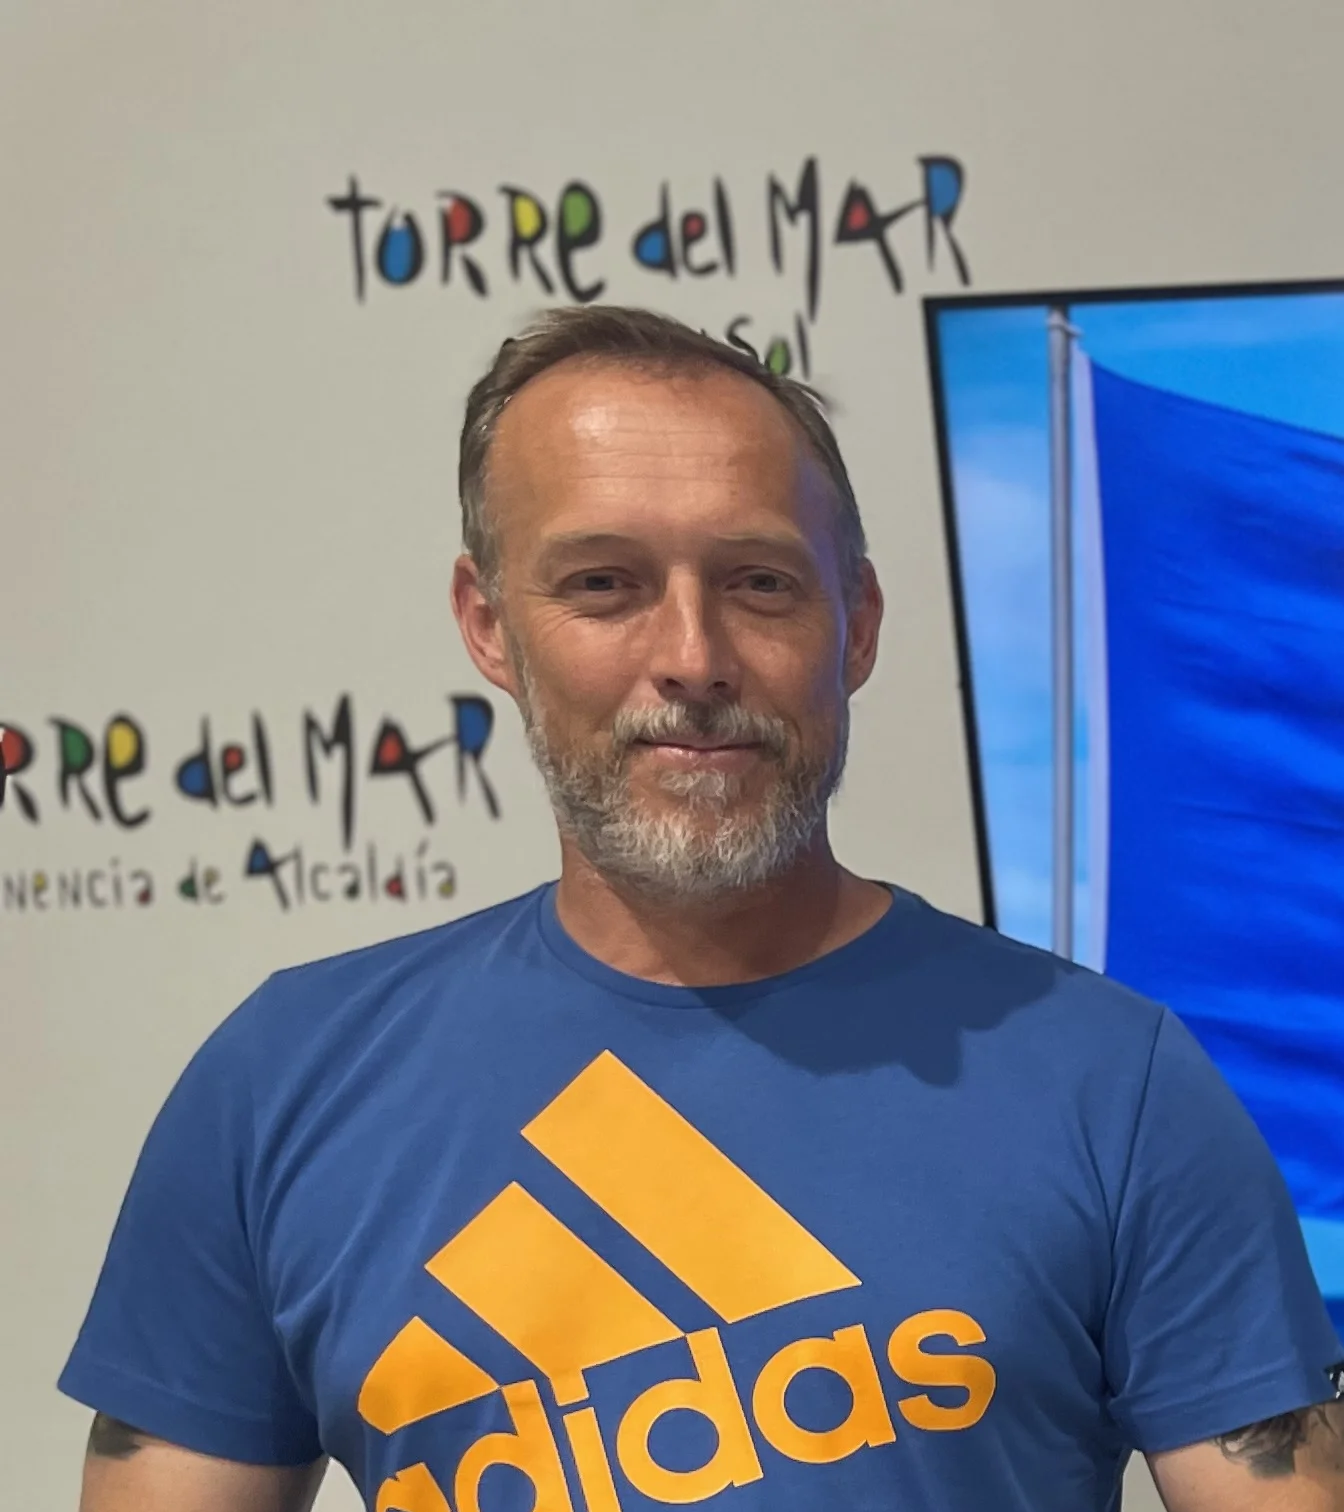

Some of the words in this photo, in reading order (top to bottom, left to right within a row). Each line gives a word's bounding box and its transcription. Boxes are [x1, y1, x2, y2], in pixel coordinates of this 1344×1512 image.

[632, 183, 736, 278] del
[766, 156, 971, 322] MAR
[173, 708, 274, 810] del
[302, 692, 501, 854] MAR
